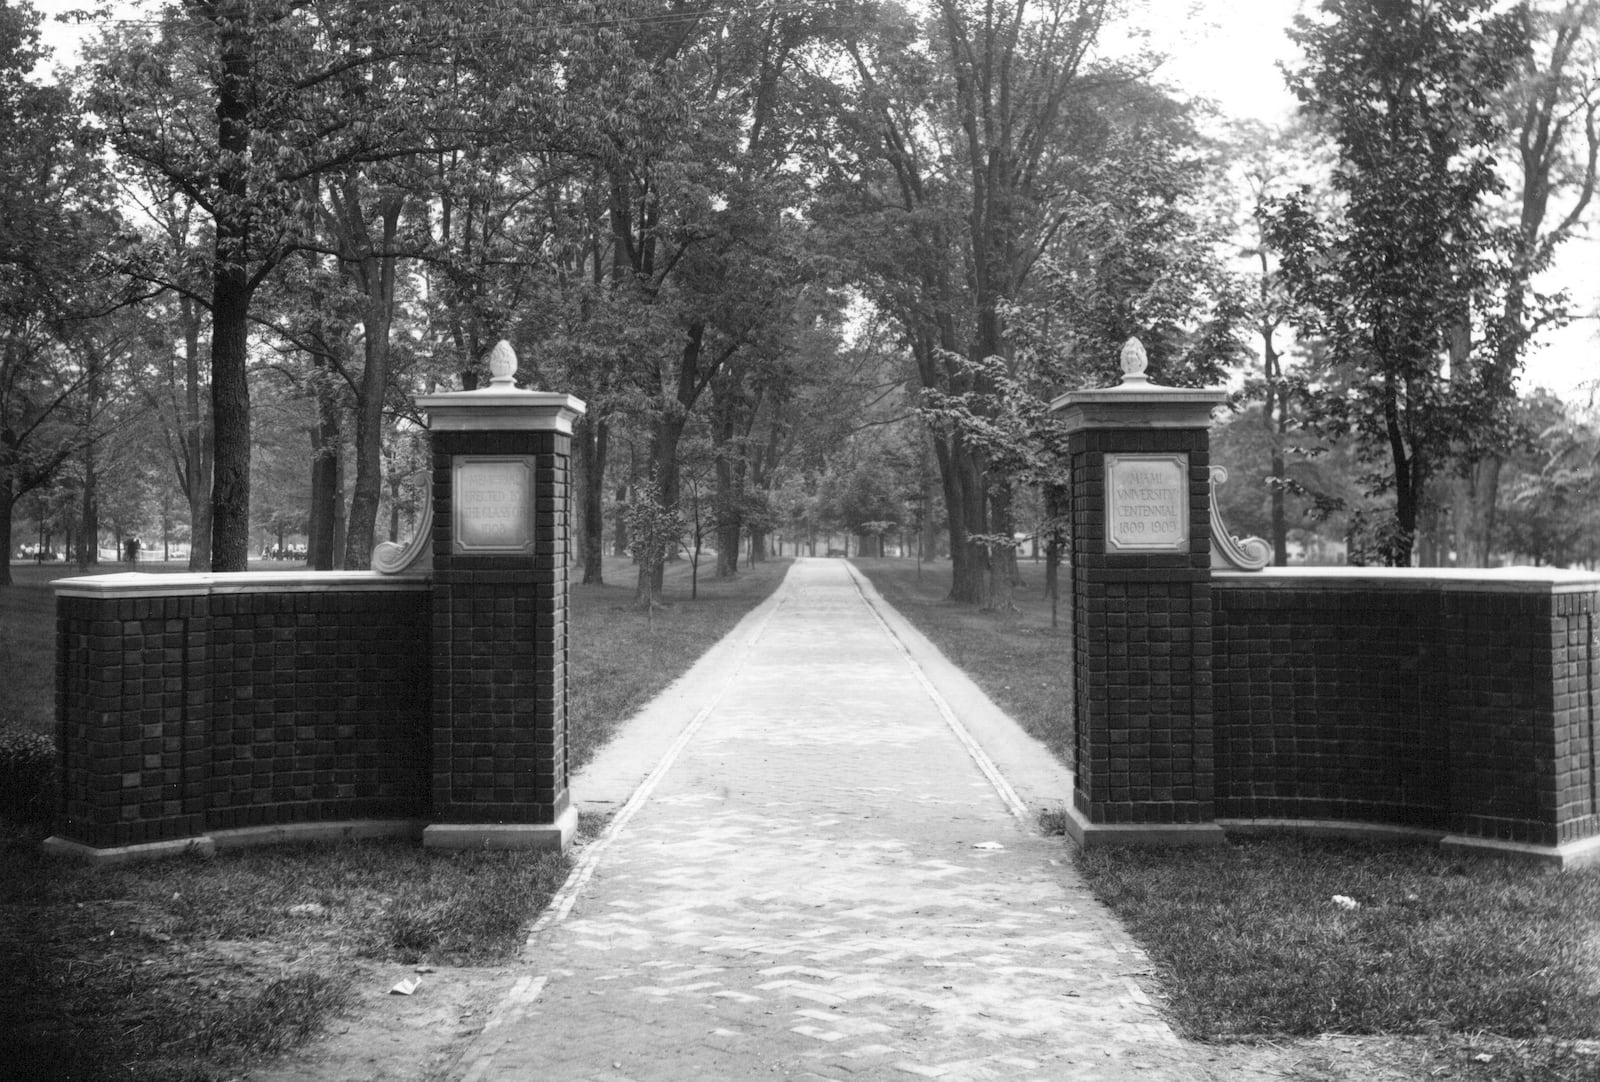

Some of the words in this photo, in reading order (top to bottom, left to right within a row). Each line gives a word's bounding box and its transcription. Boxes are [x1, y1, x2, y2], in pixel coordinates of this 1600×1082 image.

[1129, 472, 1162, 484] MIAMI
[466, 490, 505, 502] ERECTED
[464, 506, 481, 518] THE
[482, 506, 511, 518] CLASS
[1118, 505, 1177, 517] CENTENNIAL
[1120, 521, 1145, 534] 1809
[1151, 520, 1177, 533] 1909
